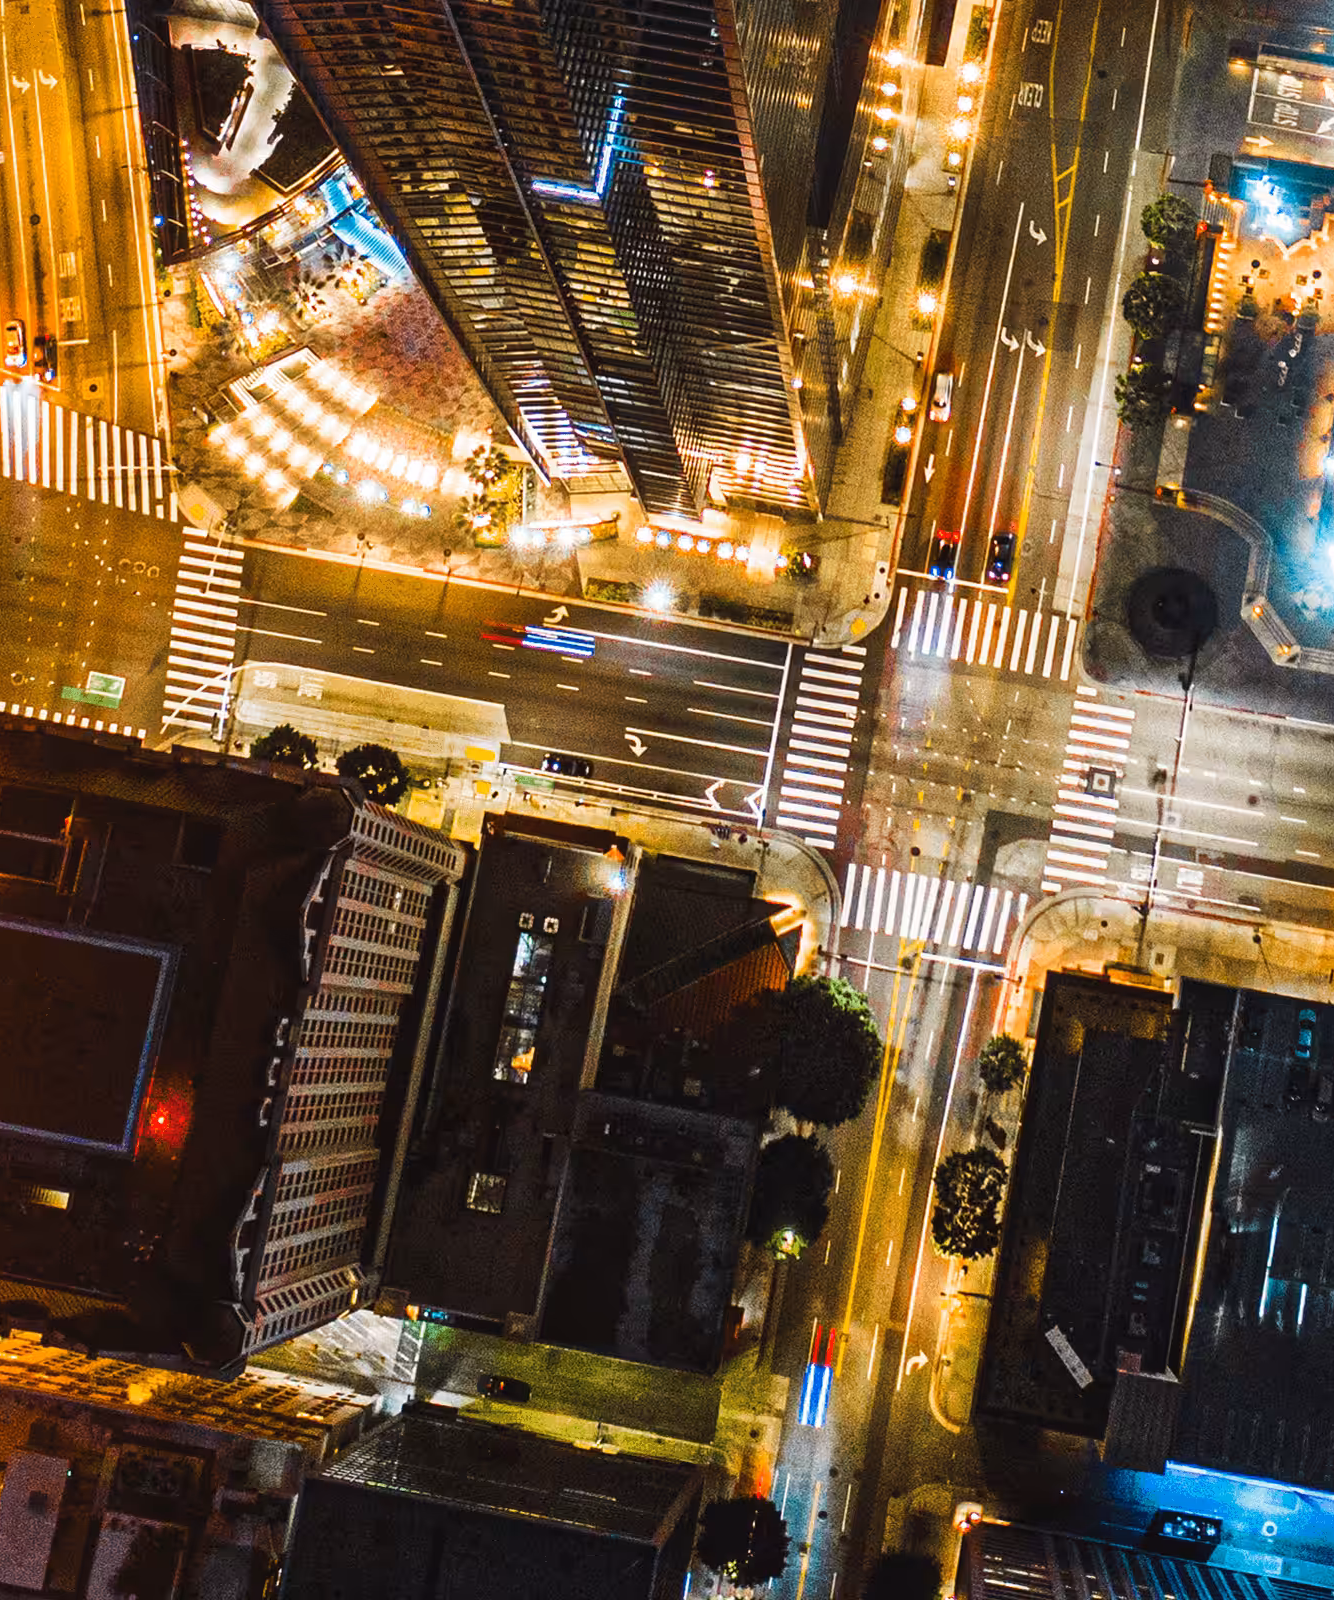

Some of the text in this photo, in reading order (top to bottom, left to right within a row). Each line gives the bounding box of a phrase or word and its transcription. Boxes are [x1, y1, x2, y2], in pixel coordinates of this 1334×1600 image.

[1031, 19, 1053, 45] KEEP
[1017, 81, 1044, 109] CLEAR
[1276, 73, 1304, 100] STOP
[1272, 102, 1300, 127] STOP
